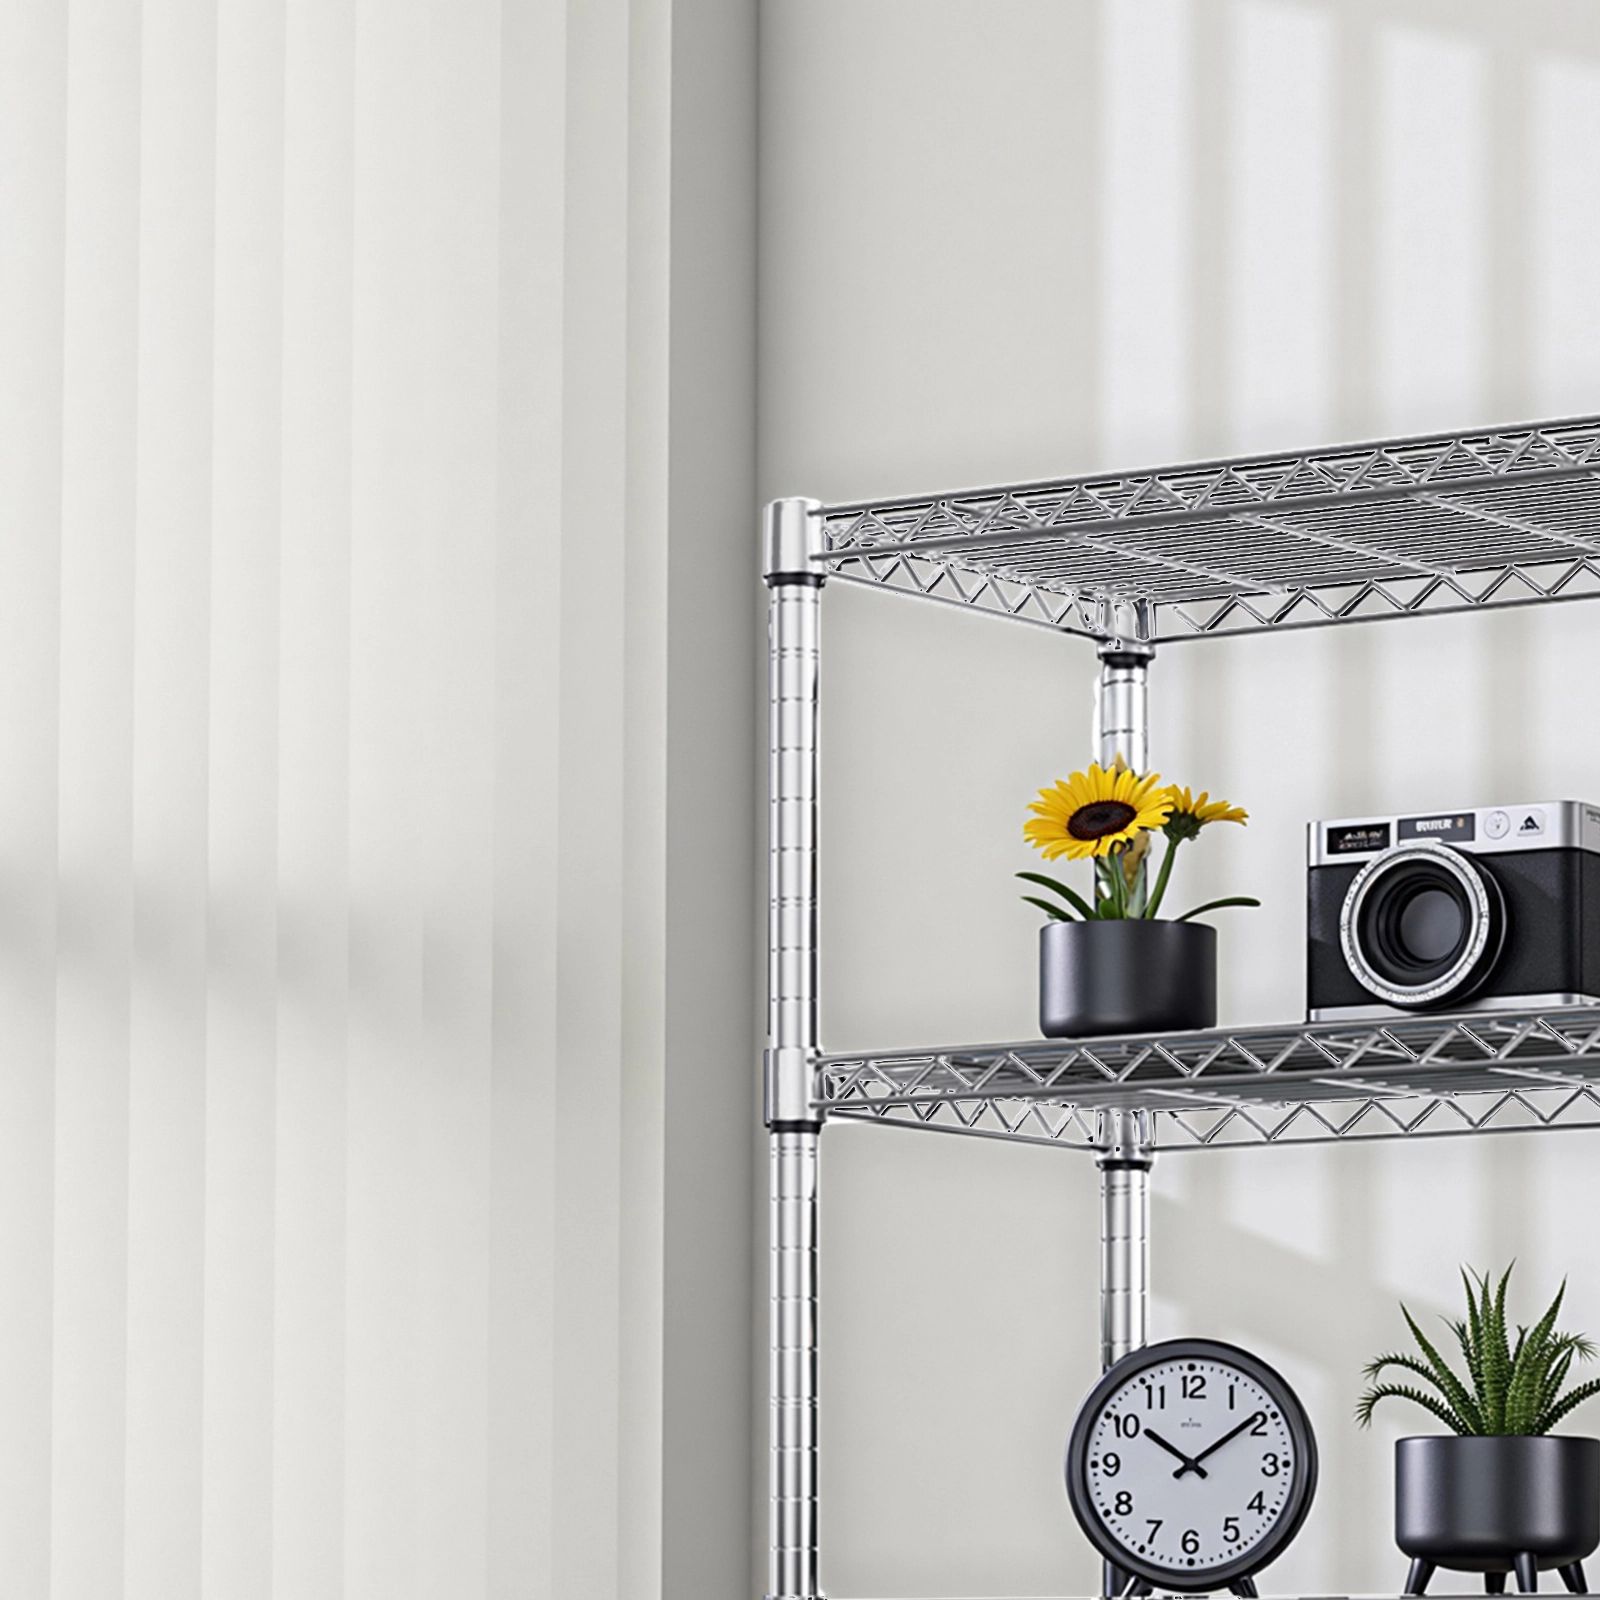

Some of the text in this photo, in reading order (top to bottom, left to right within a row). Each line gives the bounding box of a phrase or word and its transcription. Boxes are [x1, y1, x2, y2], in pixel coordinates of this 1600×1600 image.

[1145, 1385, 1165, 1409] 11
[1181, 1375, 1206, 1399] 12
[1228, 1384, 1236, 1411] 1
[1114, 1414, 1140, 1438] 10
[1249, 1411, 1267, 1436] 2
[1103, 1453, 1120, 1477] 9
[1261, 1453, 1279, 1477] 3
[1115, 1491, 1133, 1516] 8
[1247, 1491, 1266, 1515] 4
[1146, 1520, 1163, 1544] 7
[1223, 1517, 1240, 1542] 5
[1181, 1530, 1199, 1554] 6
